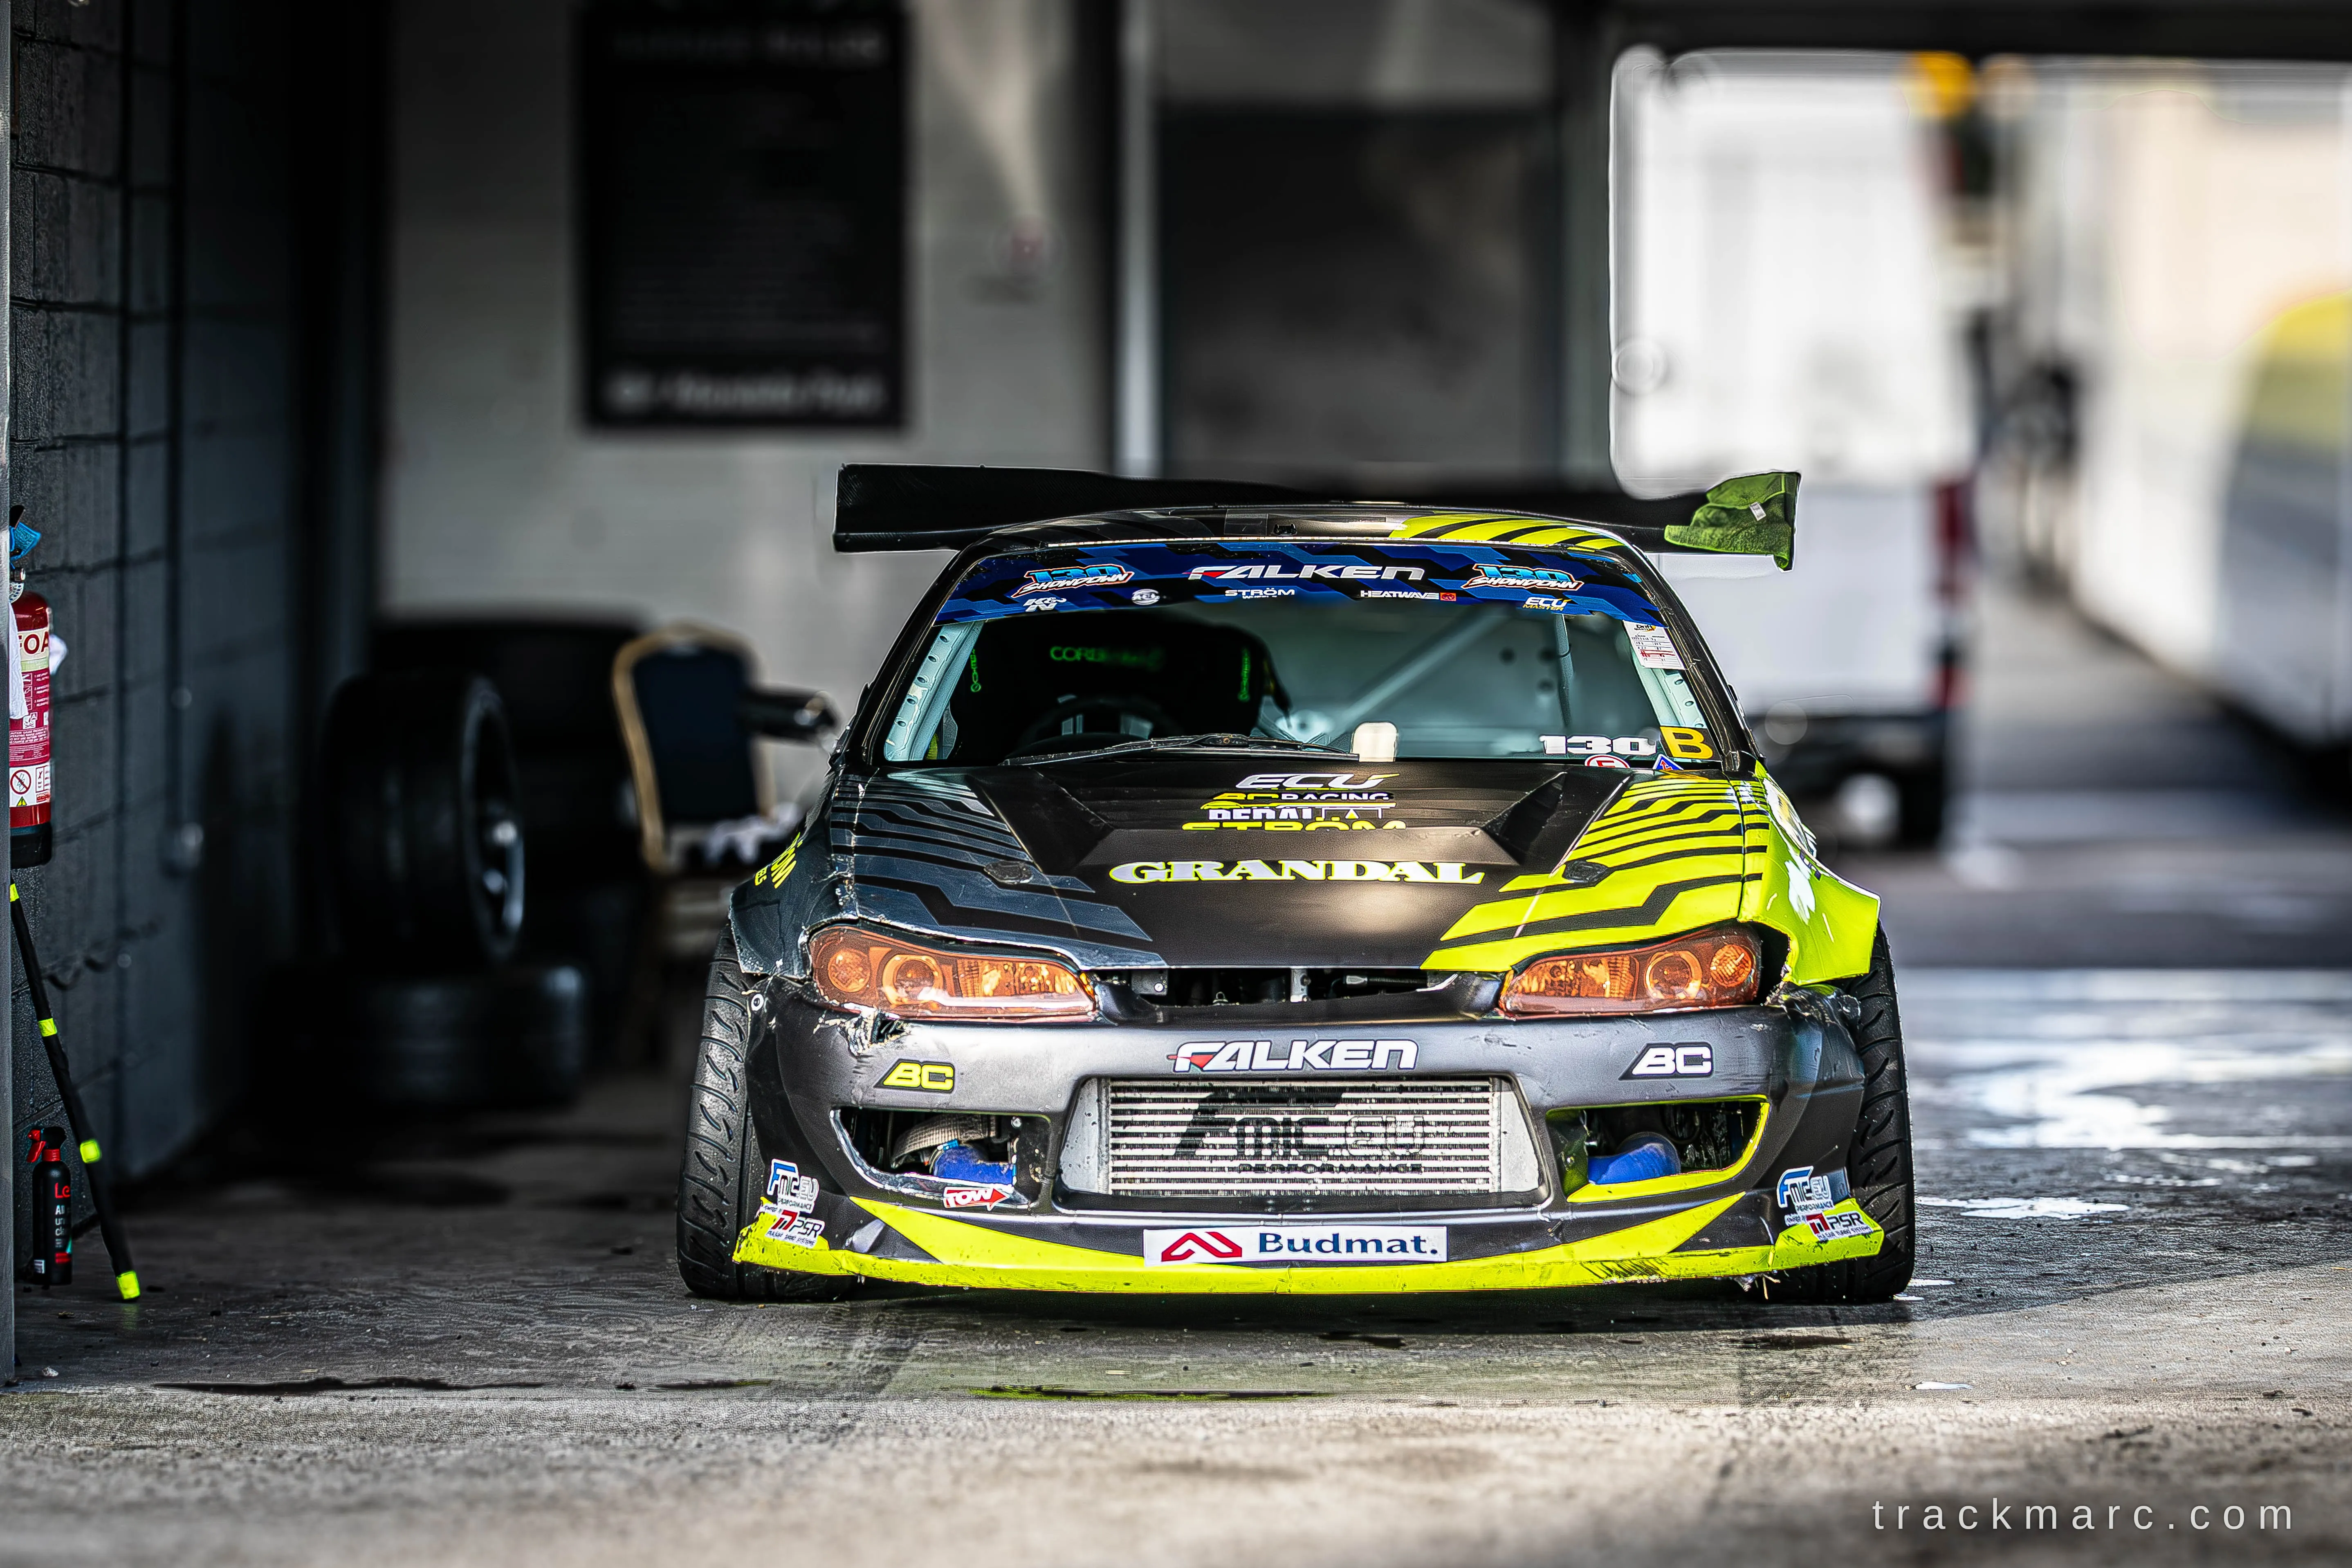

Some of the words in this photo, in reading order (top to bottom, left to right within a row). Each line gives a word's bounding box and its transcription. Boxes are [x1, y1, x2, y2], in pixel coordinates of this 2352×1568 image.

[1030, 565, 1122, 583] 130
[1188, 565, 1425, 580] FALKEN
[1477, 565, 1571, 582] 130
[1019, 572, 1130, 594] SHOWDOWN
[1468, 577, 1578, 588] SHOWDOWN
[1225, 588, 1295, 596] STRÖM
[1360, 590, 1439, 599] HEATWAVE
[1023, 597, 1066, 612] K&N
[1525, 597, 1572, 608] ECU
[1539, 736, 1657, 756] 130
[1660, 726, 1713, 759] B
[1236, 773, 1400, 789] ECU
[1109, 860, 1485, 884] GRANDAL
[1171, 1040, 1418, 1072] FALKEN
[1632, 1046, 1712, 1075] BC
[883, 1062, 954, 1090] BC
[945, 1188, 993, 1208] TOW
[789, 1219, 822, 1238] PSR
[1826, 1213, 1865, 1230] PSR
[1258, 1232, 1439, 1255] Budmat.
